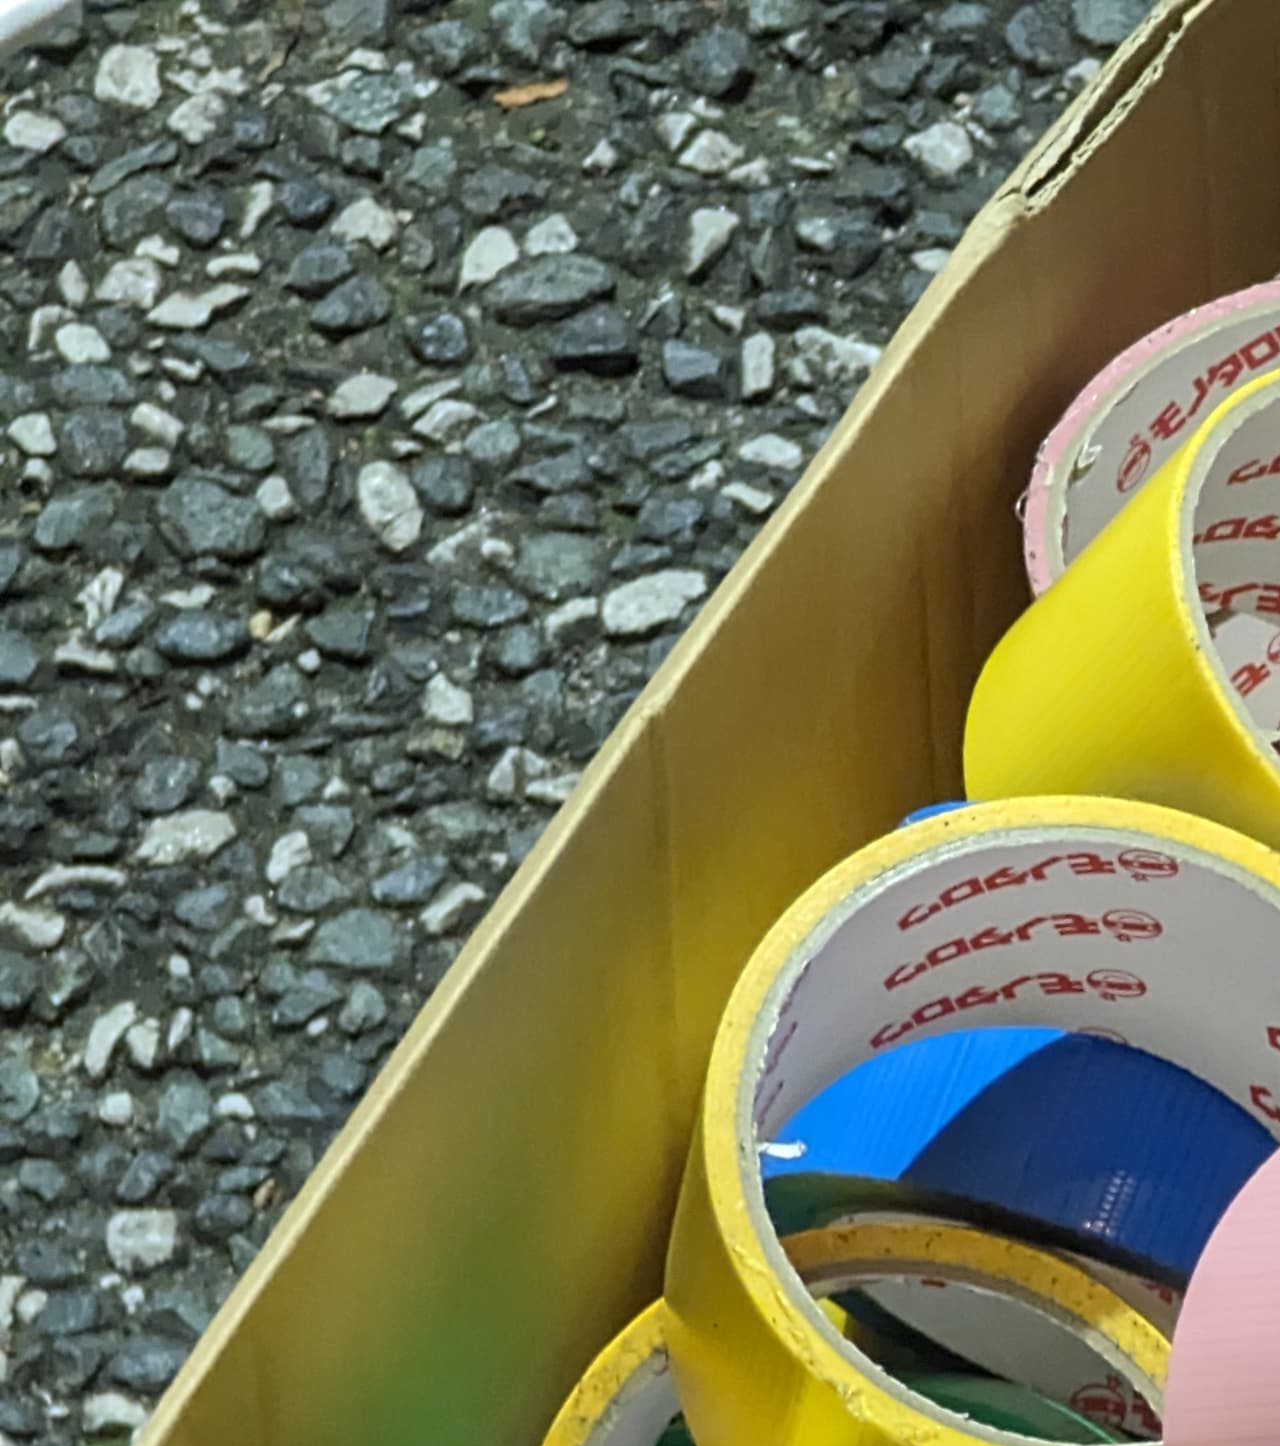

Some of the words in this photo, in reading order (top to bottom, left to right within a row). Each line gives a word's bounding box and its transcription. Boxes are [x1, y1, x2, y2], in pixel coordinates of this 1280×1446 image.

[897, 852, 1116, 931] モノタロウ
[883, 913, 1101, 992] モノタロウ
[869, 973, 1085, 1049] モノタロウ
